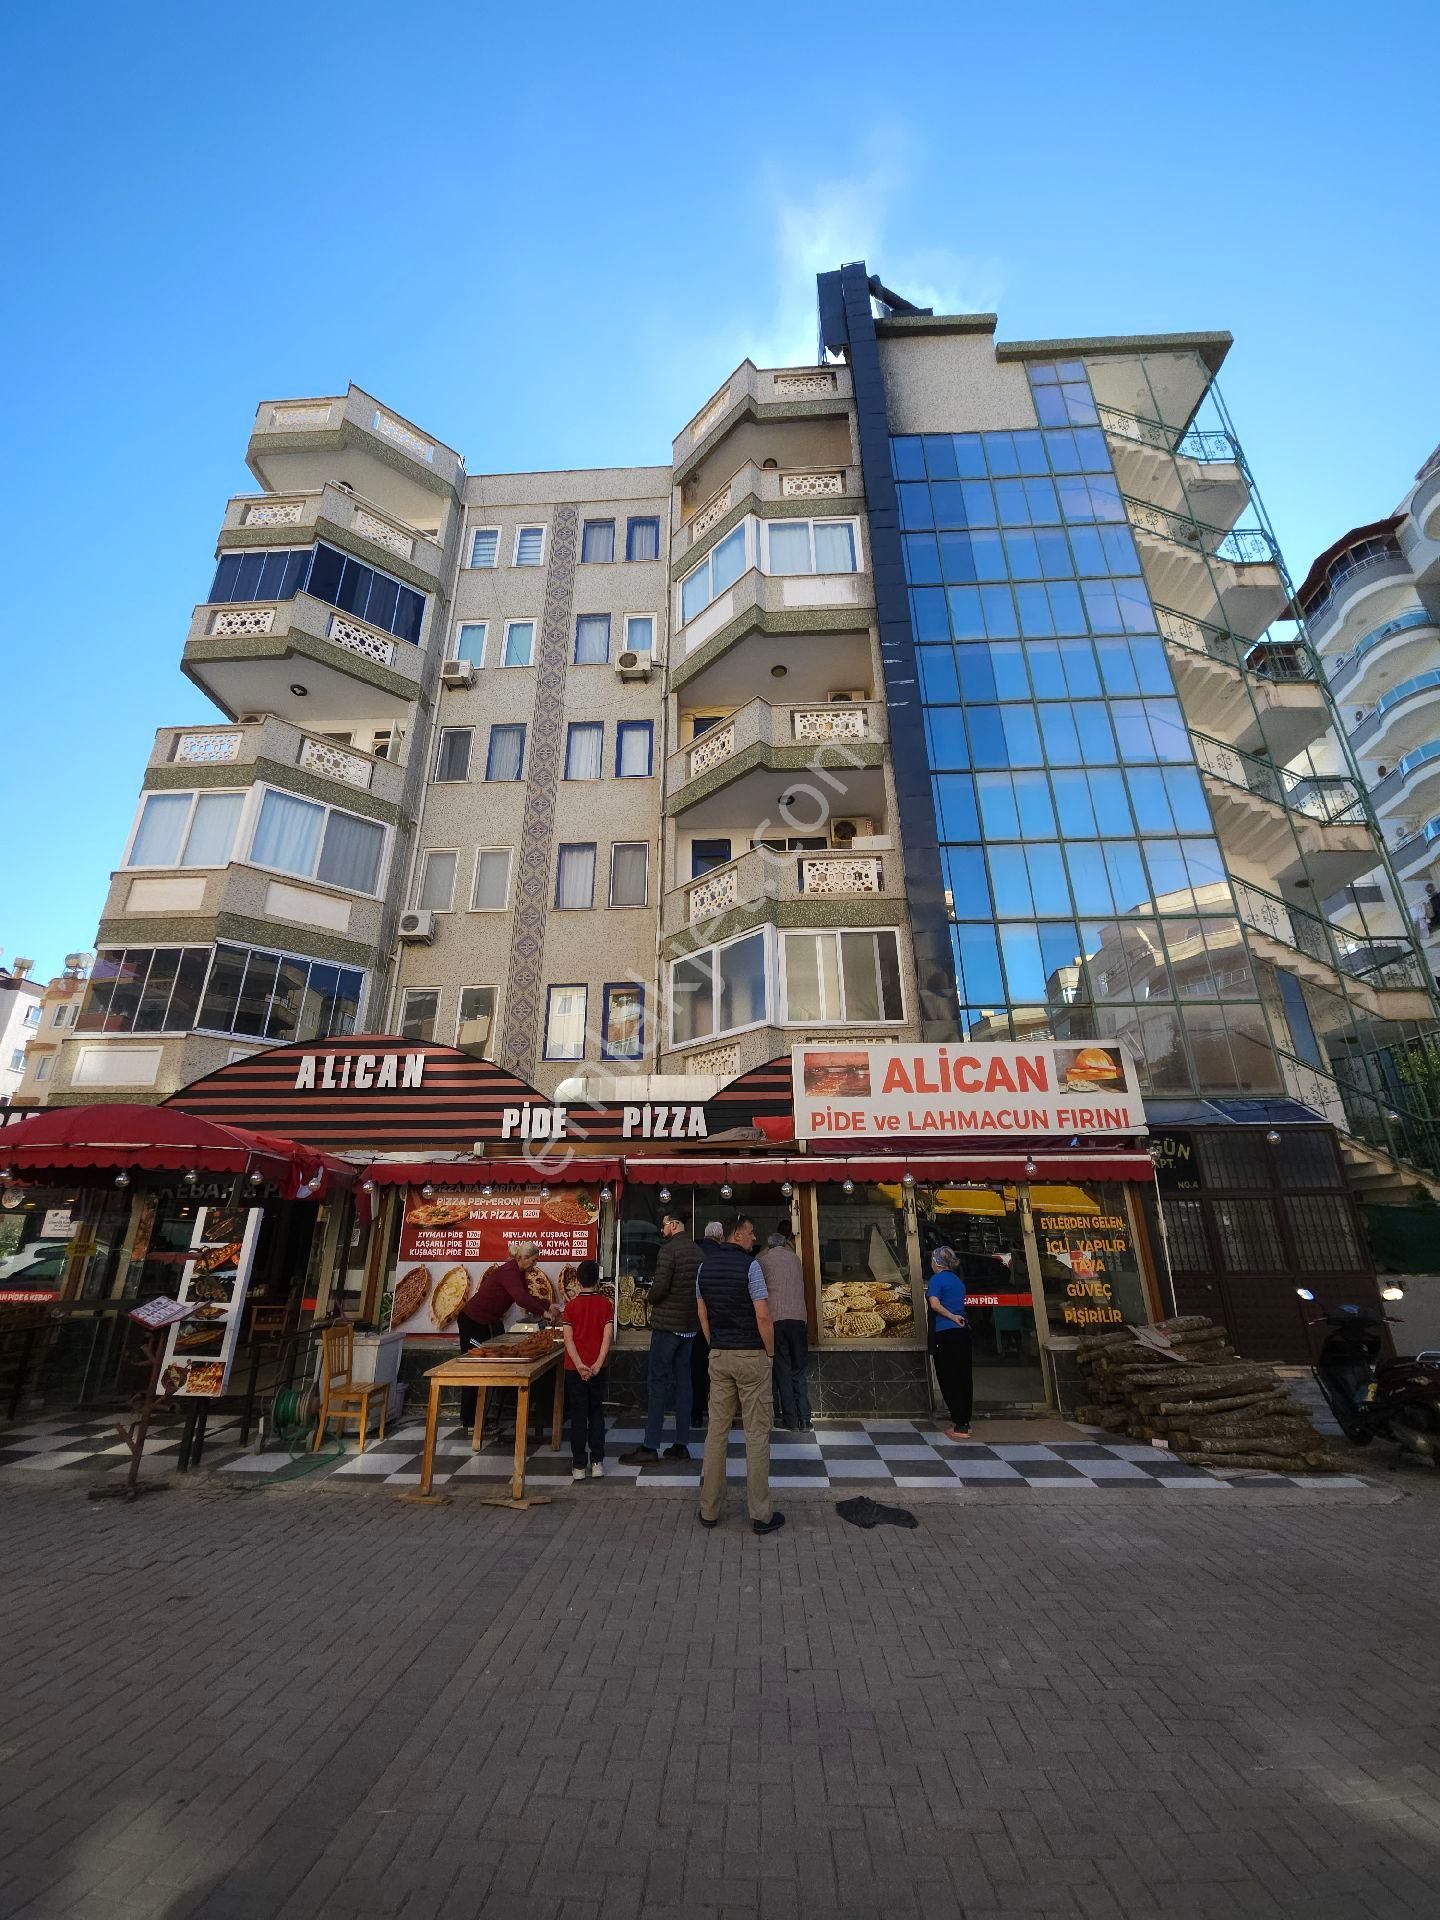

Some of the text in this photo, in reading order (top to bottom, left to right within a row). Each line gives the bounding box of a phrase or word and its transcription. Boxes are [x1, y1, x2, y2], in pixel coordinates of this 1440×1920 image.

[881, 1048, 1049, 1093] ALİCAN
[501, 1101, 708, 1138] PİDE PİZZA
[811, 1106, 1130, 1131] PİDE ve LAHMACUN FIRINI
[490, 1209, 519, 1219] PİZZA
[1040, 1216, 1124, 1230] EVLERDEN GELEN
[1076, 1239, 1126, 1252] YAPILIR
[1066, 1280, 1112, 1300] GÜVEÇ
[979, 1296, 999, 1305] PİDE
